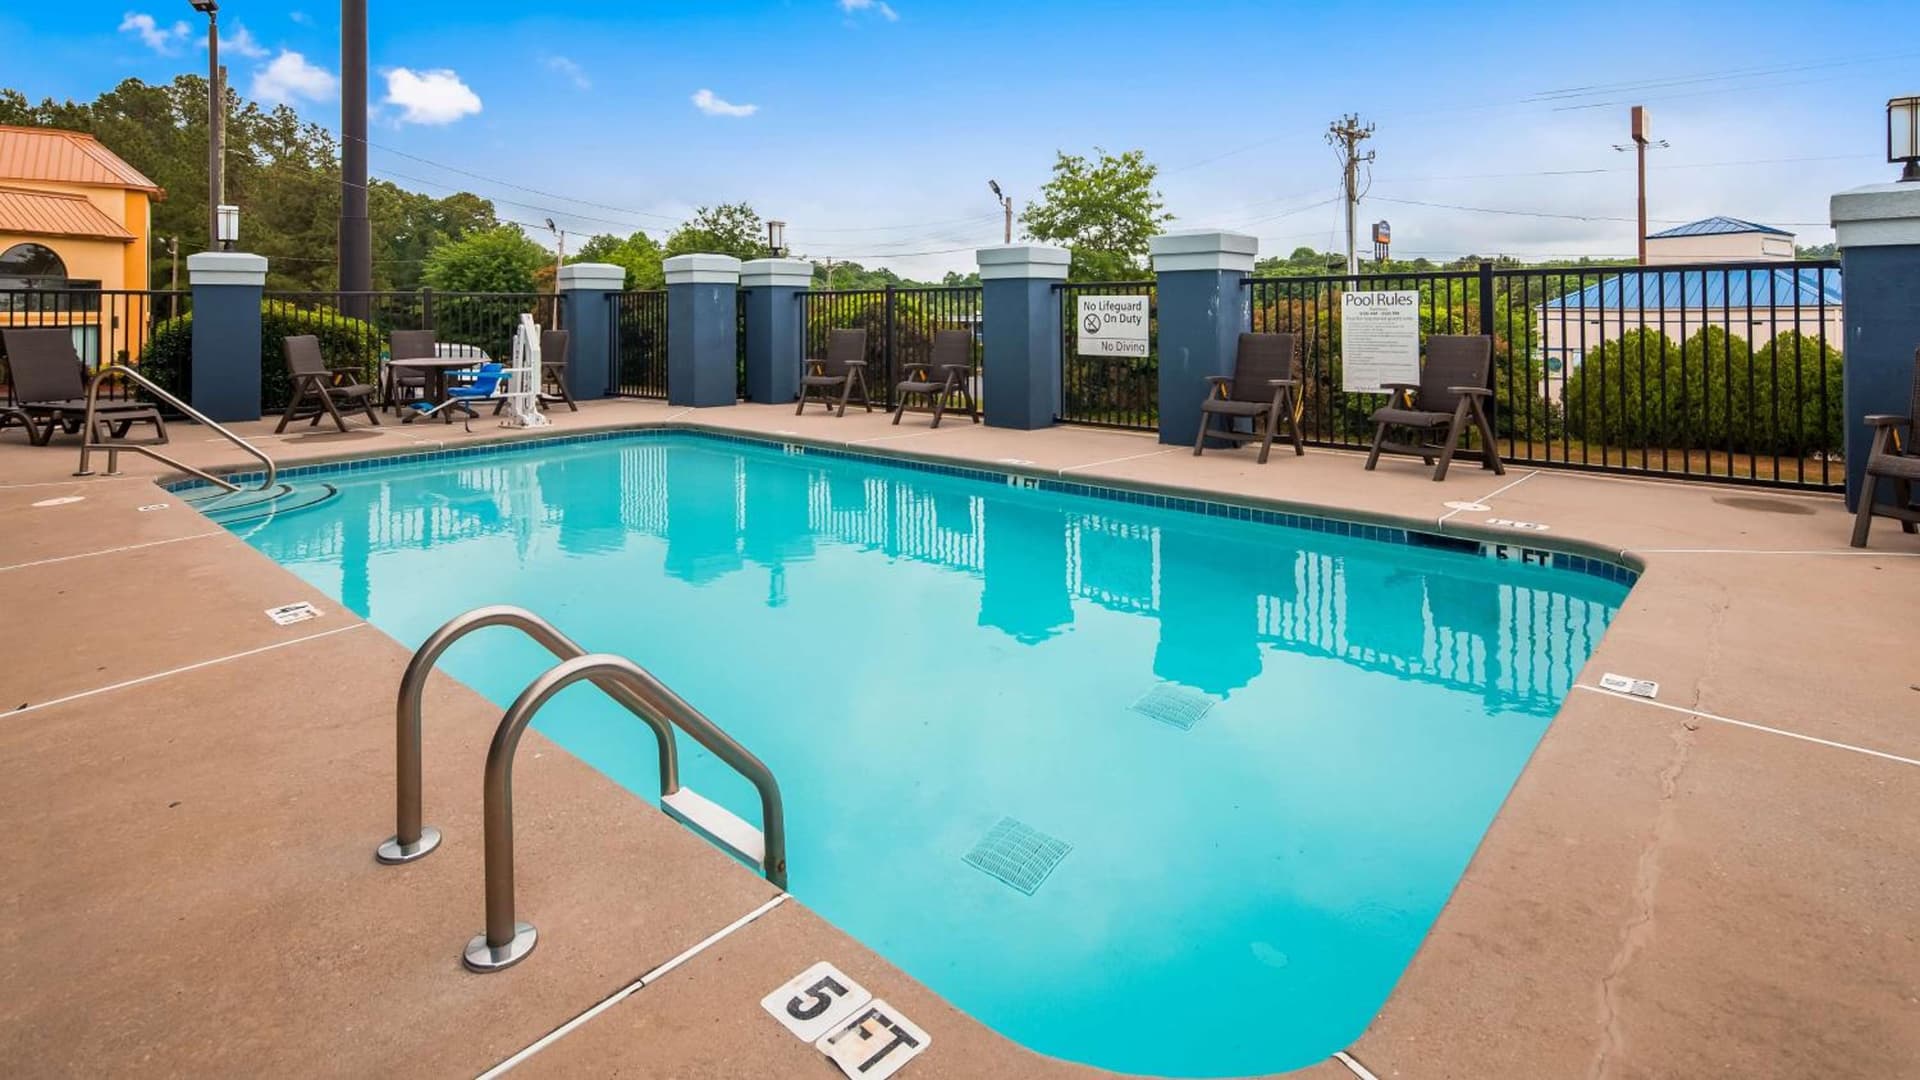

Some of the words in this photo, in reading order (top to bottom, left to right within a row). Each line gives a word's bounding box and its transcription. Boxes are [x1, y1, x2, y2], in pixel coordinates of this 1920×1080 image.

[1346, 293, 1374, 306] Pool
[1377, 292, 1413, 306] Rules
[1083, 301, 1096, 311] No
[1099, 301, 1142, 313] Lifeguard
[1103, 313, 1117, 323] On
[1119, 313, 1142, 326] Duty
[1101, 341, 1113, 352] No
[1116, 341, 1145, 354] Diving
[1522, 548, 1550, 567] FT
[786, 975, 849, 1021] 5
[827, 1007, 920, 1073] FT
